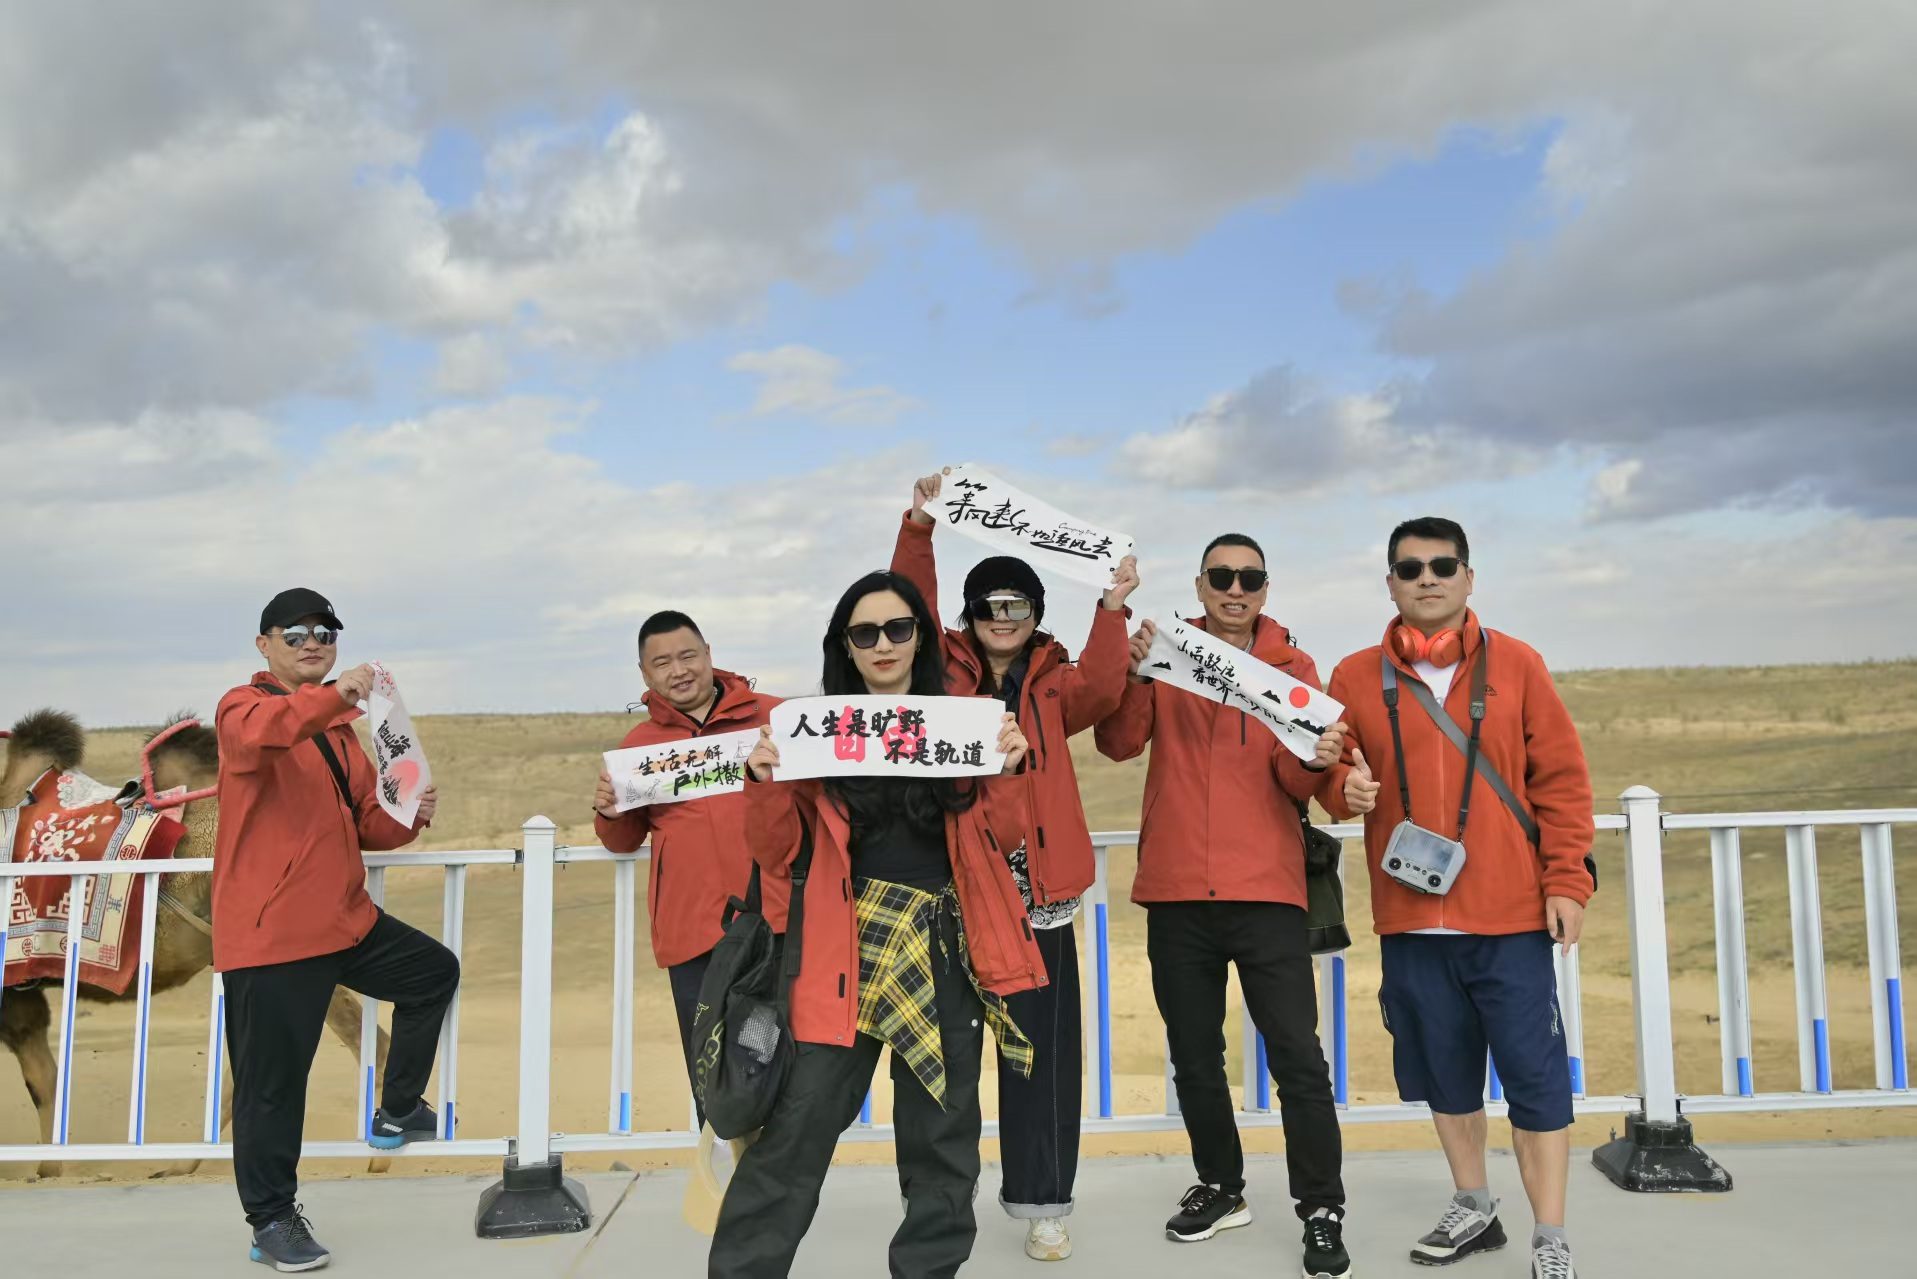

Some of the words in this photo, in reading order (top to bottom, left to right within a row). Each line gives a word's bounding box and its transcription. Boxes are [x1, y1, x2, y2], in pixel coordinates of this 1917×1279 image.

[790, 708, 926, 738] 人生是旷野
[639, 744, 723, 776] 生活无解
[884, 737, 986, 767] 不是轨道
[673, 760, 747, 796] 户外撒
